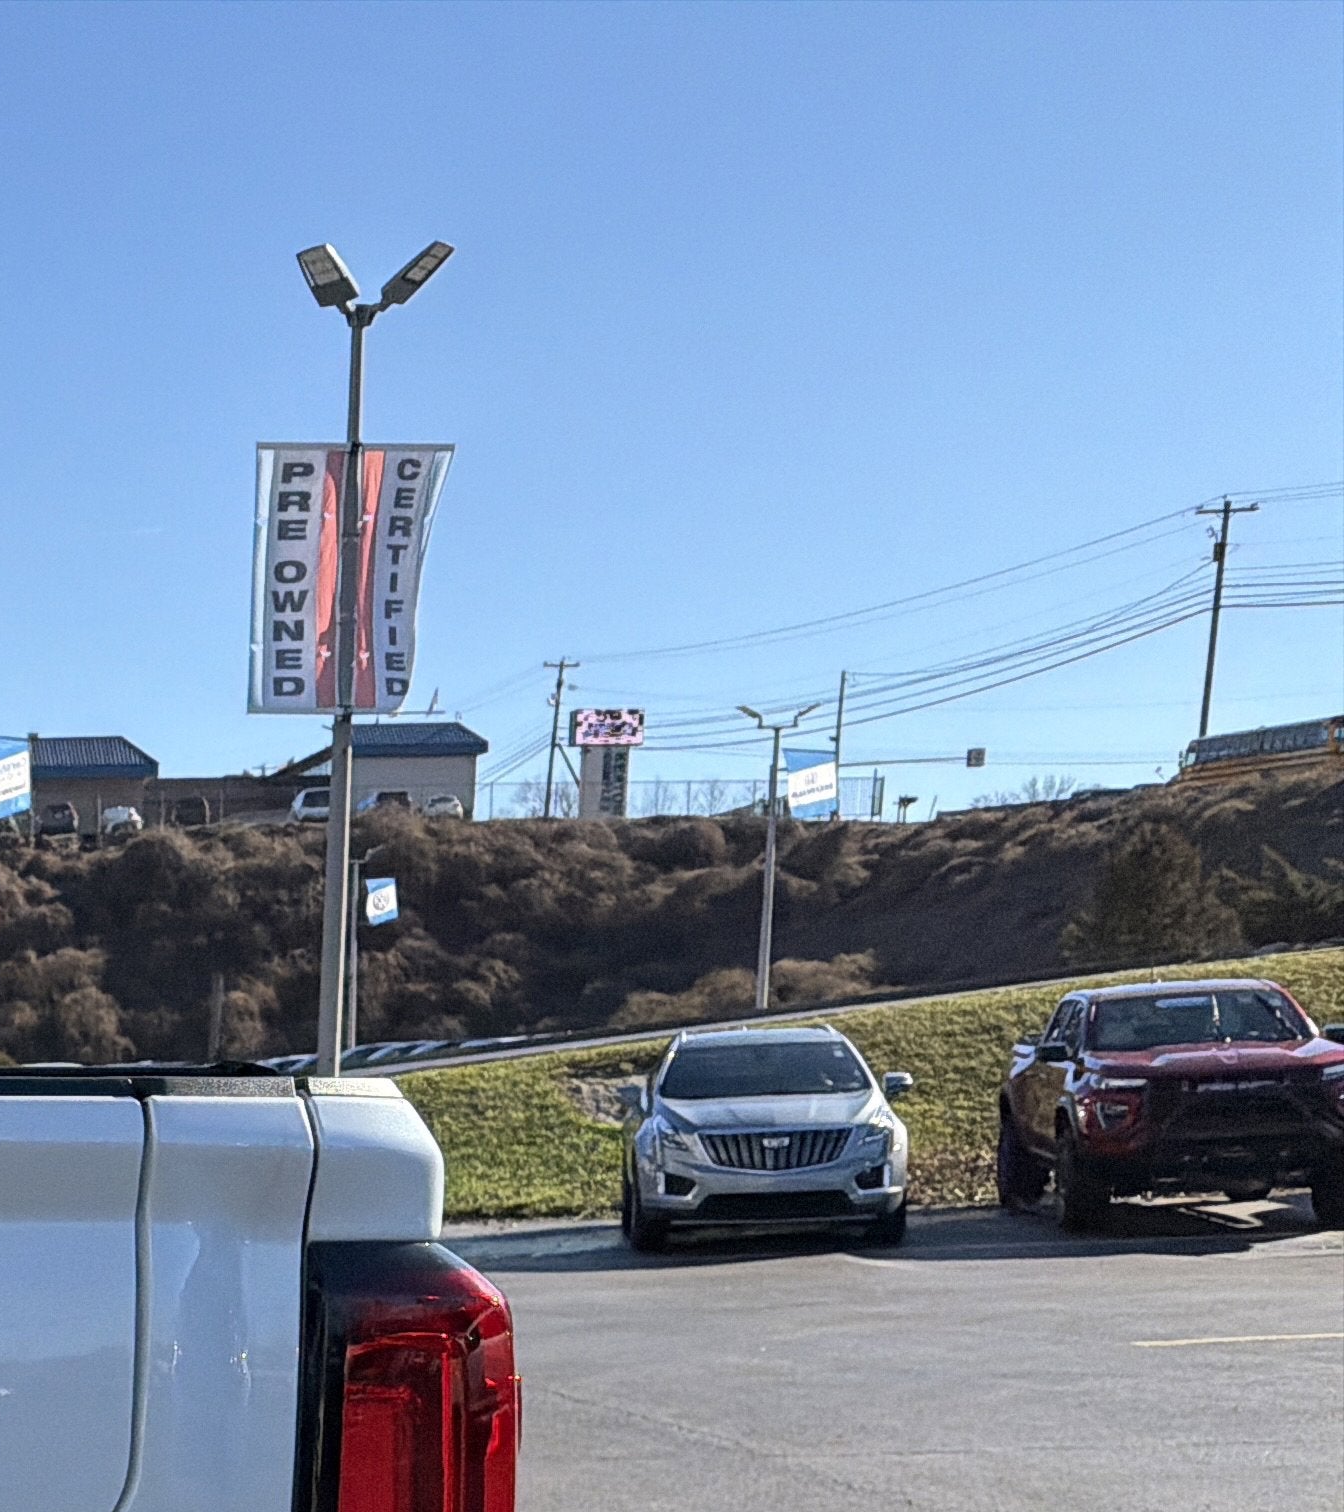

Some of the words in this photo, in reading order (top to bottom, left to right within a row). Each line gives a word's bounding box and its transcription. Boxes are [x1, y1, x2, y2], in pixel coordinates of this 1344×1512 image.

[276, 461, 316, 542] PRE
[271, 559, 310, 698] OWNED
[384, 457, 422, 698] CERTIFIED
